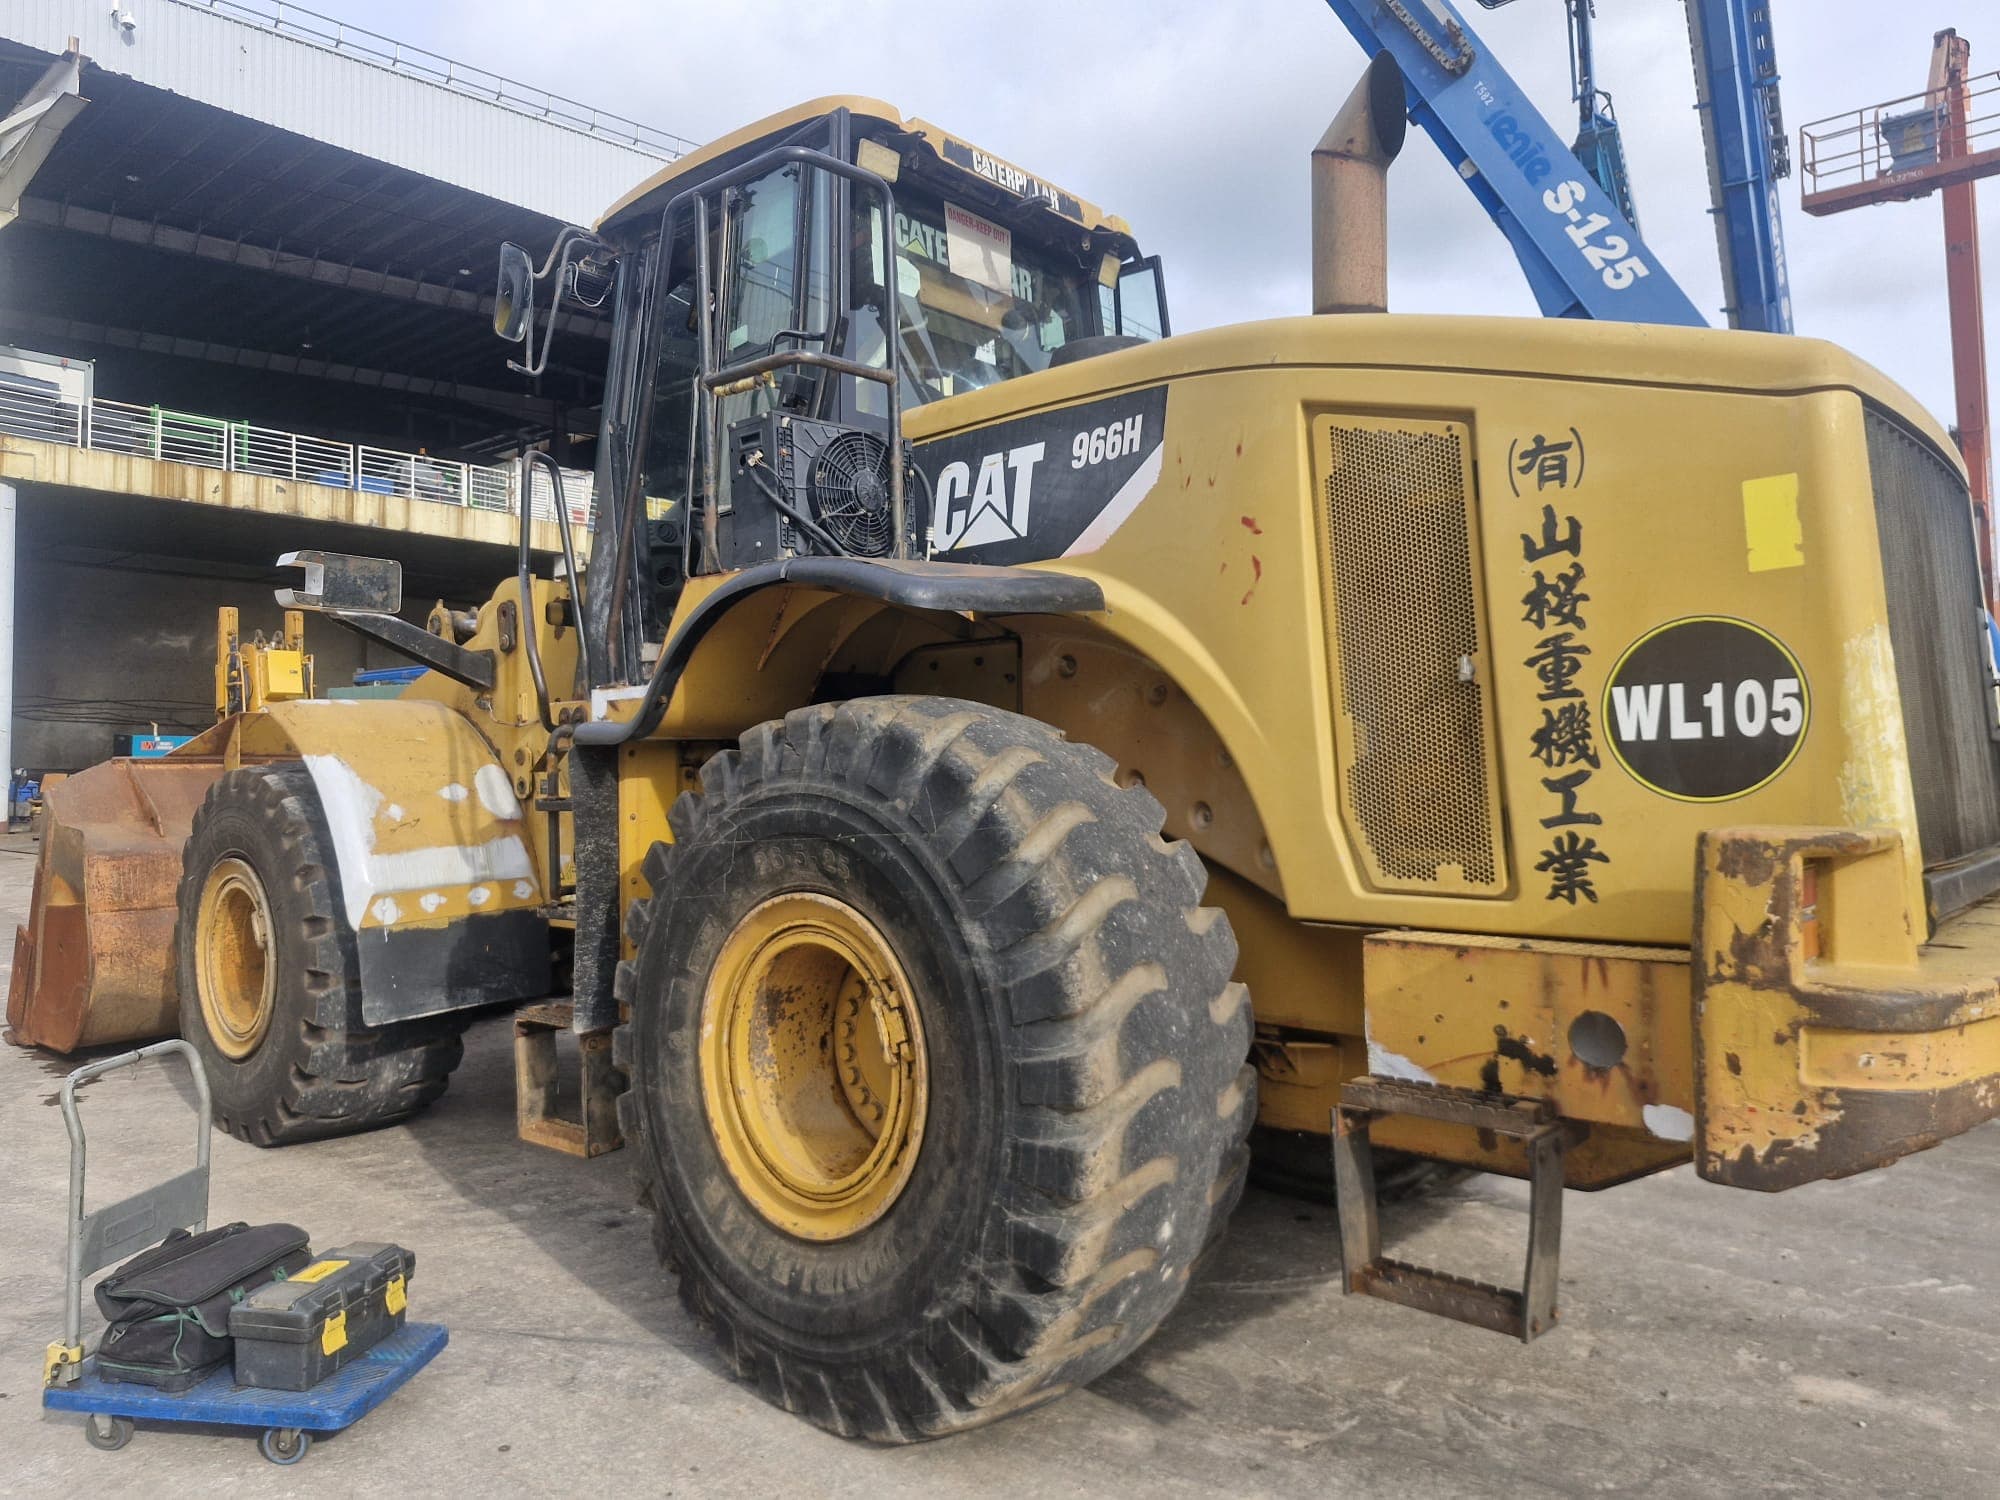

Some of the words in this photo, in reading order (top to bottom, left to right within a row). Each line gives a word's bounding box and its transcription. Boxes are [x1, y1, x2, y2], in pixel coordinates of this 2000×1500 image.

[1543, 180, 1650, 290] S-125
[1071, 413, 1144, 469] 966H
[934, 441, 1046, 552] CAT
[1611, 677, 1804, 742] WL105
